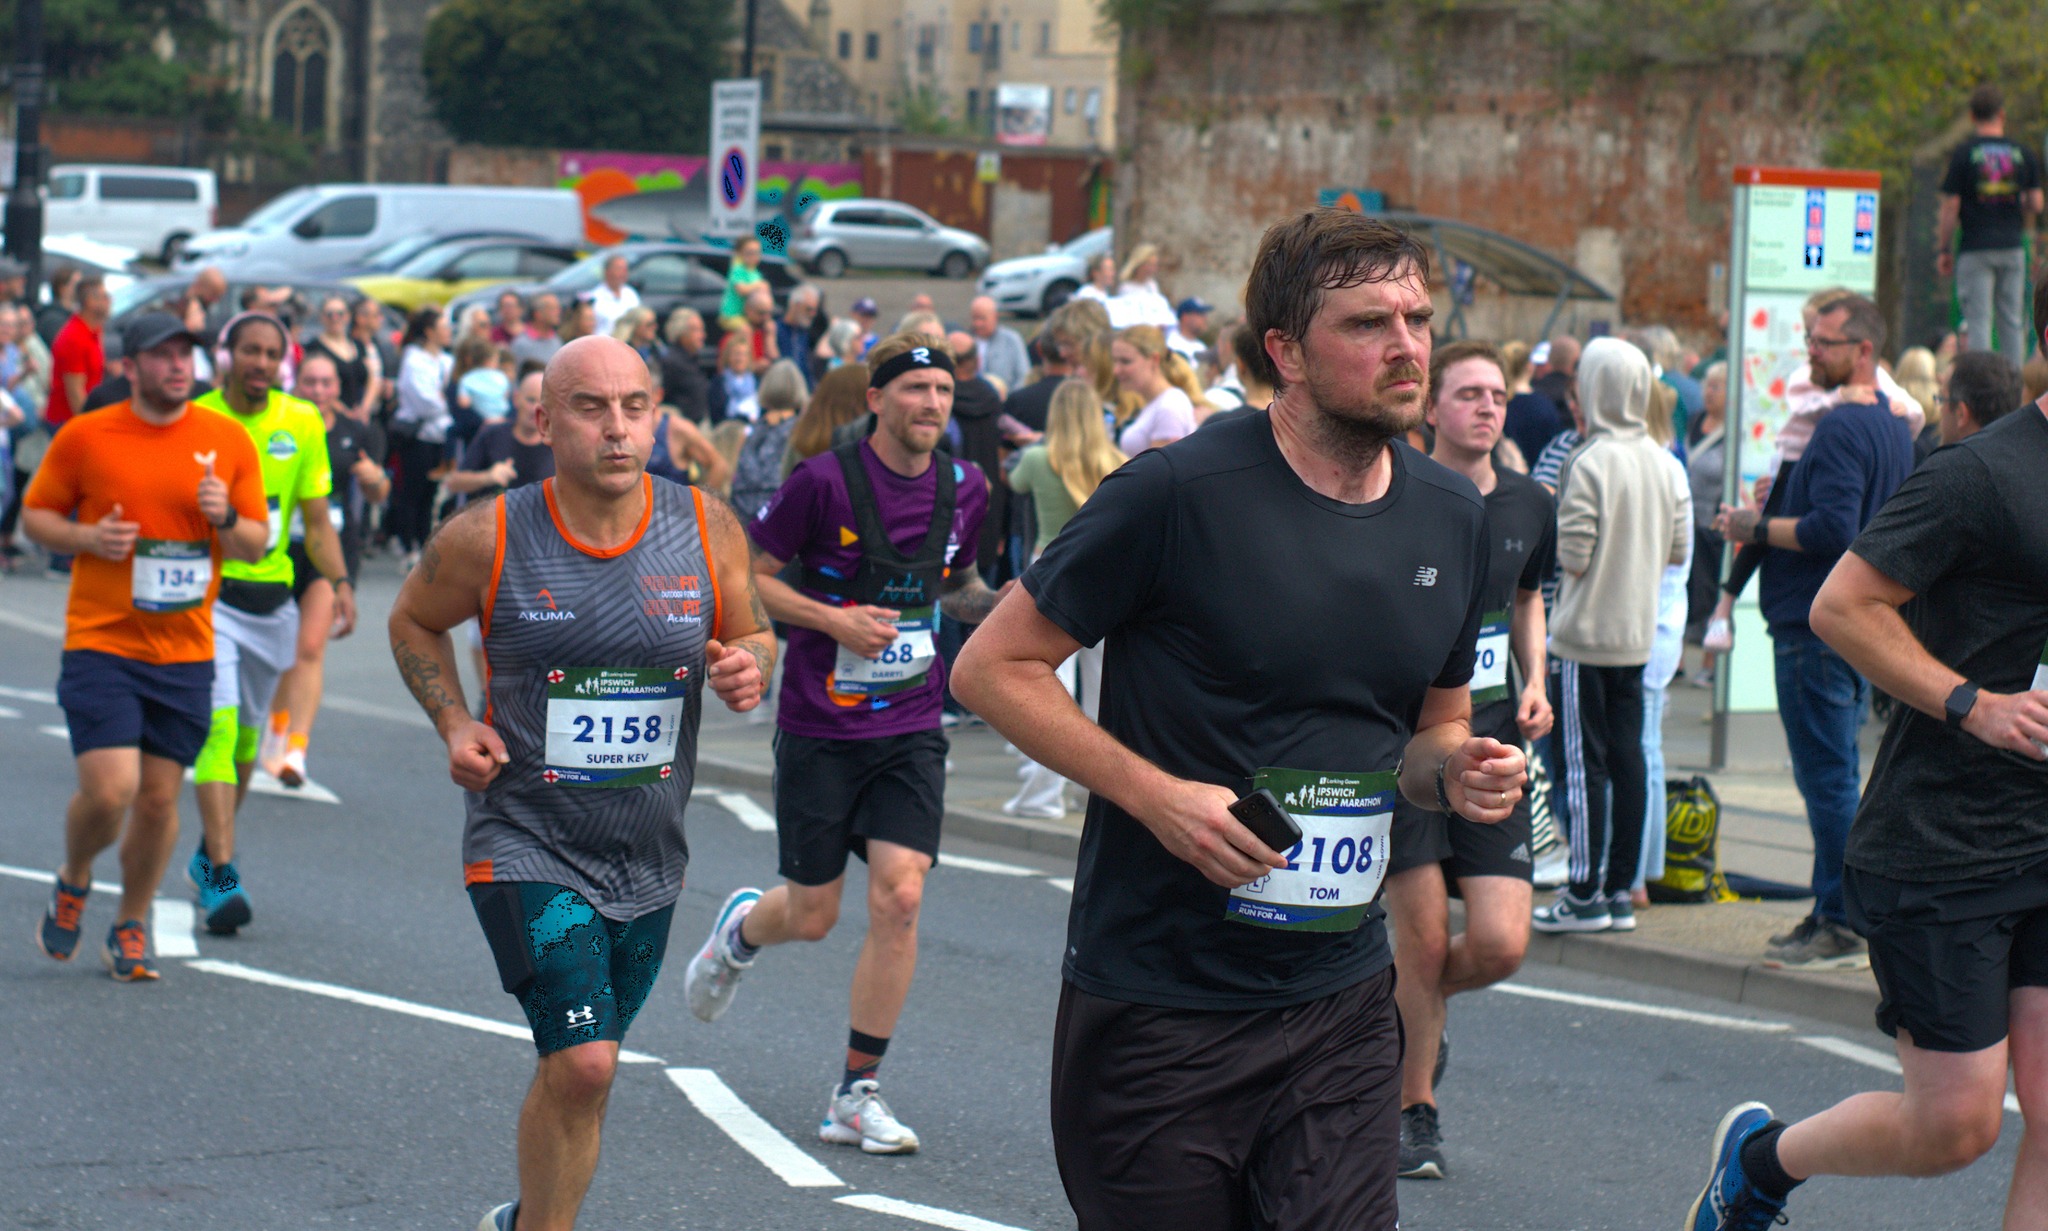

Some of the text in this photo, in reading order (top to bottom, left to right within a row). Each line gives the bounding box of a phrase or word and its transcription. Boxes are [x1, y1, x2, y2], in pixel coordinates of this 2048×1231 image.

[159, 569, 195, 587] 134
[518, 611, 576, 622] AKUMA
[667, 613, 702, 627] Academy
[865, 643, 913, 665] 68
[600, 679, 635, 687] IPSWICH
[621, 686, 667, 694] MARATHON
[572, 715, 662, 744] 2158
[586, 753, 650, 764] SUPER KEV
[1326, 778, 1344, 786] Larking
[1317, 787, 1355, 797] IPSWICH
[1315, 796, 1382, 808] HALF MARATHON
[1274, 836, 1373, 875] 2108
[1309, 887, 1340, 900] TOM
[1238, 906, 1288, 922] RUN FOR ALL
